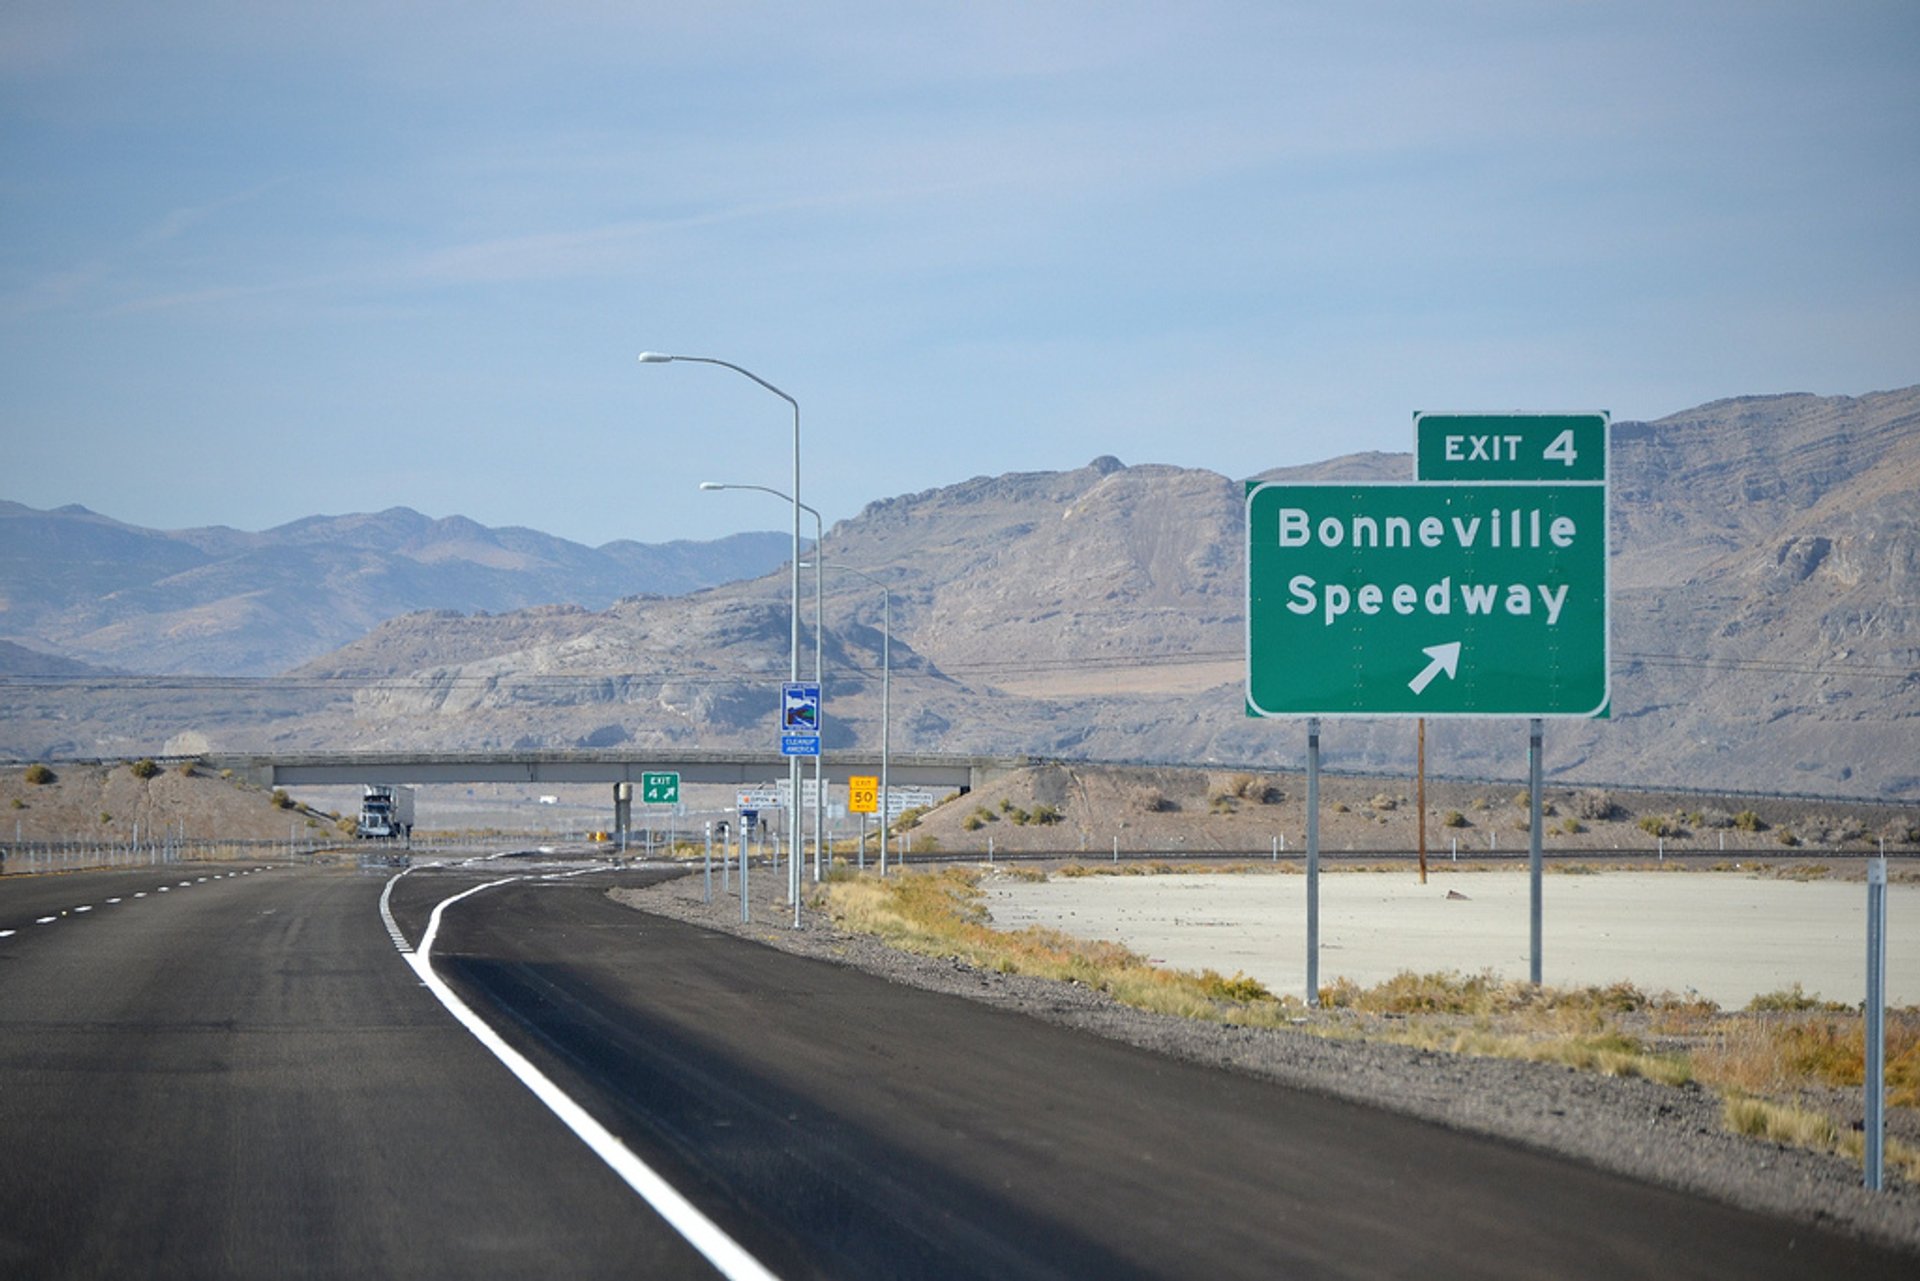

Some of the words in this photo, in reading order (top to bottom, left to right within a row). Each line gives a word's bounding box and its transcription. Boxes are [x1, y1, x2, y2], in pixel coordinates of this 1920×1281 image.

[1445, 435, 1522, 461] EXIT
[1542, 429, 1578, 467] 4
[1278, 508, 1577, 548] Bonneville
[1286, 575, 1570, 626] Speedway
[648, 787, 658, 799] 4
[650, 776, 671, 785] EXIT
[855, 791, 873, 803] 50
